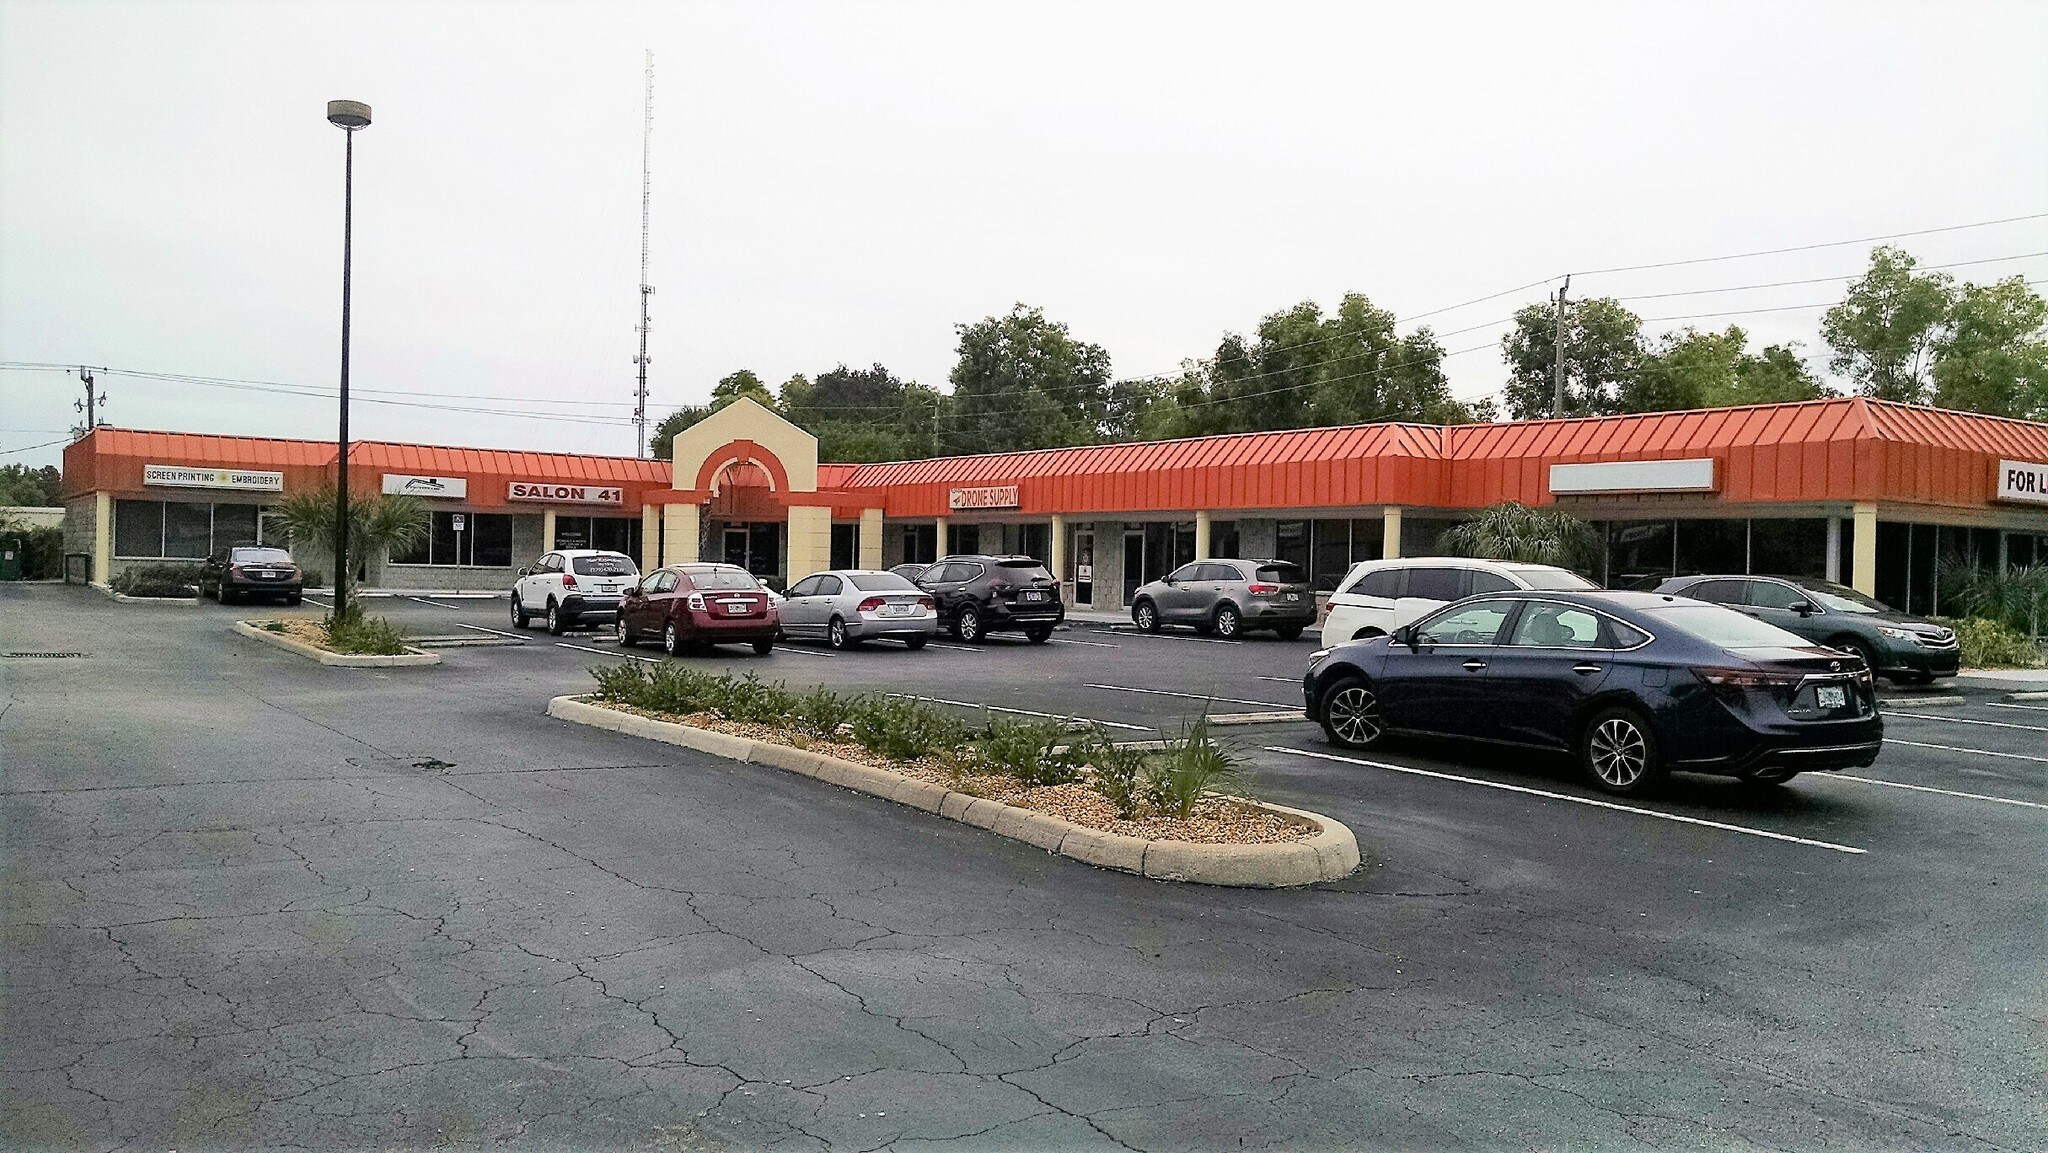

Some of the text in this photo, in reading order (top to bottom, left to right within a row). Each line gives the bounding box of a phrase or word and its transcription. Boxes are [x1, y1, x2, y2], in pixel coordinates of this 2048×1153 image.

[146, 470, 214, 482] SCREEN PRINTING
[231, 474, 280, 485] EMBROIDERY
[2007, 469, 2048, 494] FOR L
[513, 484, 620, 501] SALON 41
[961, 487, 1018, 507] DRONE SUPPLY
